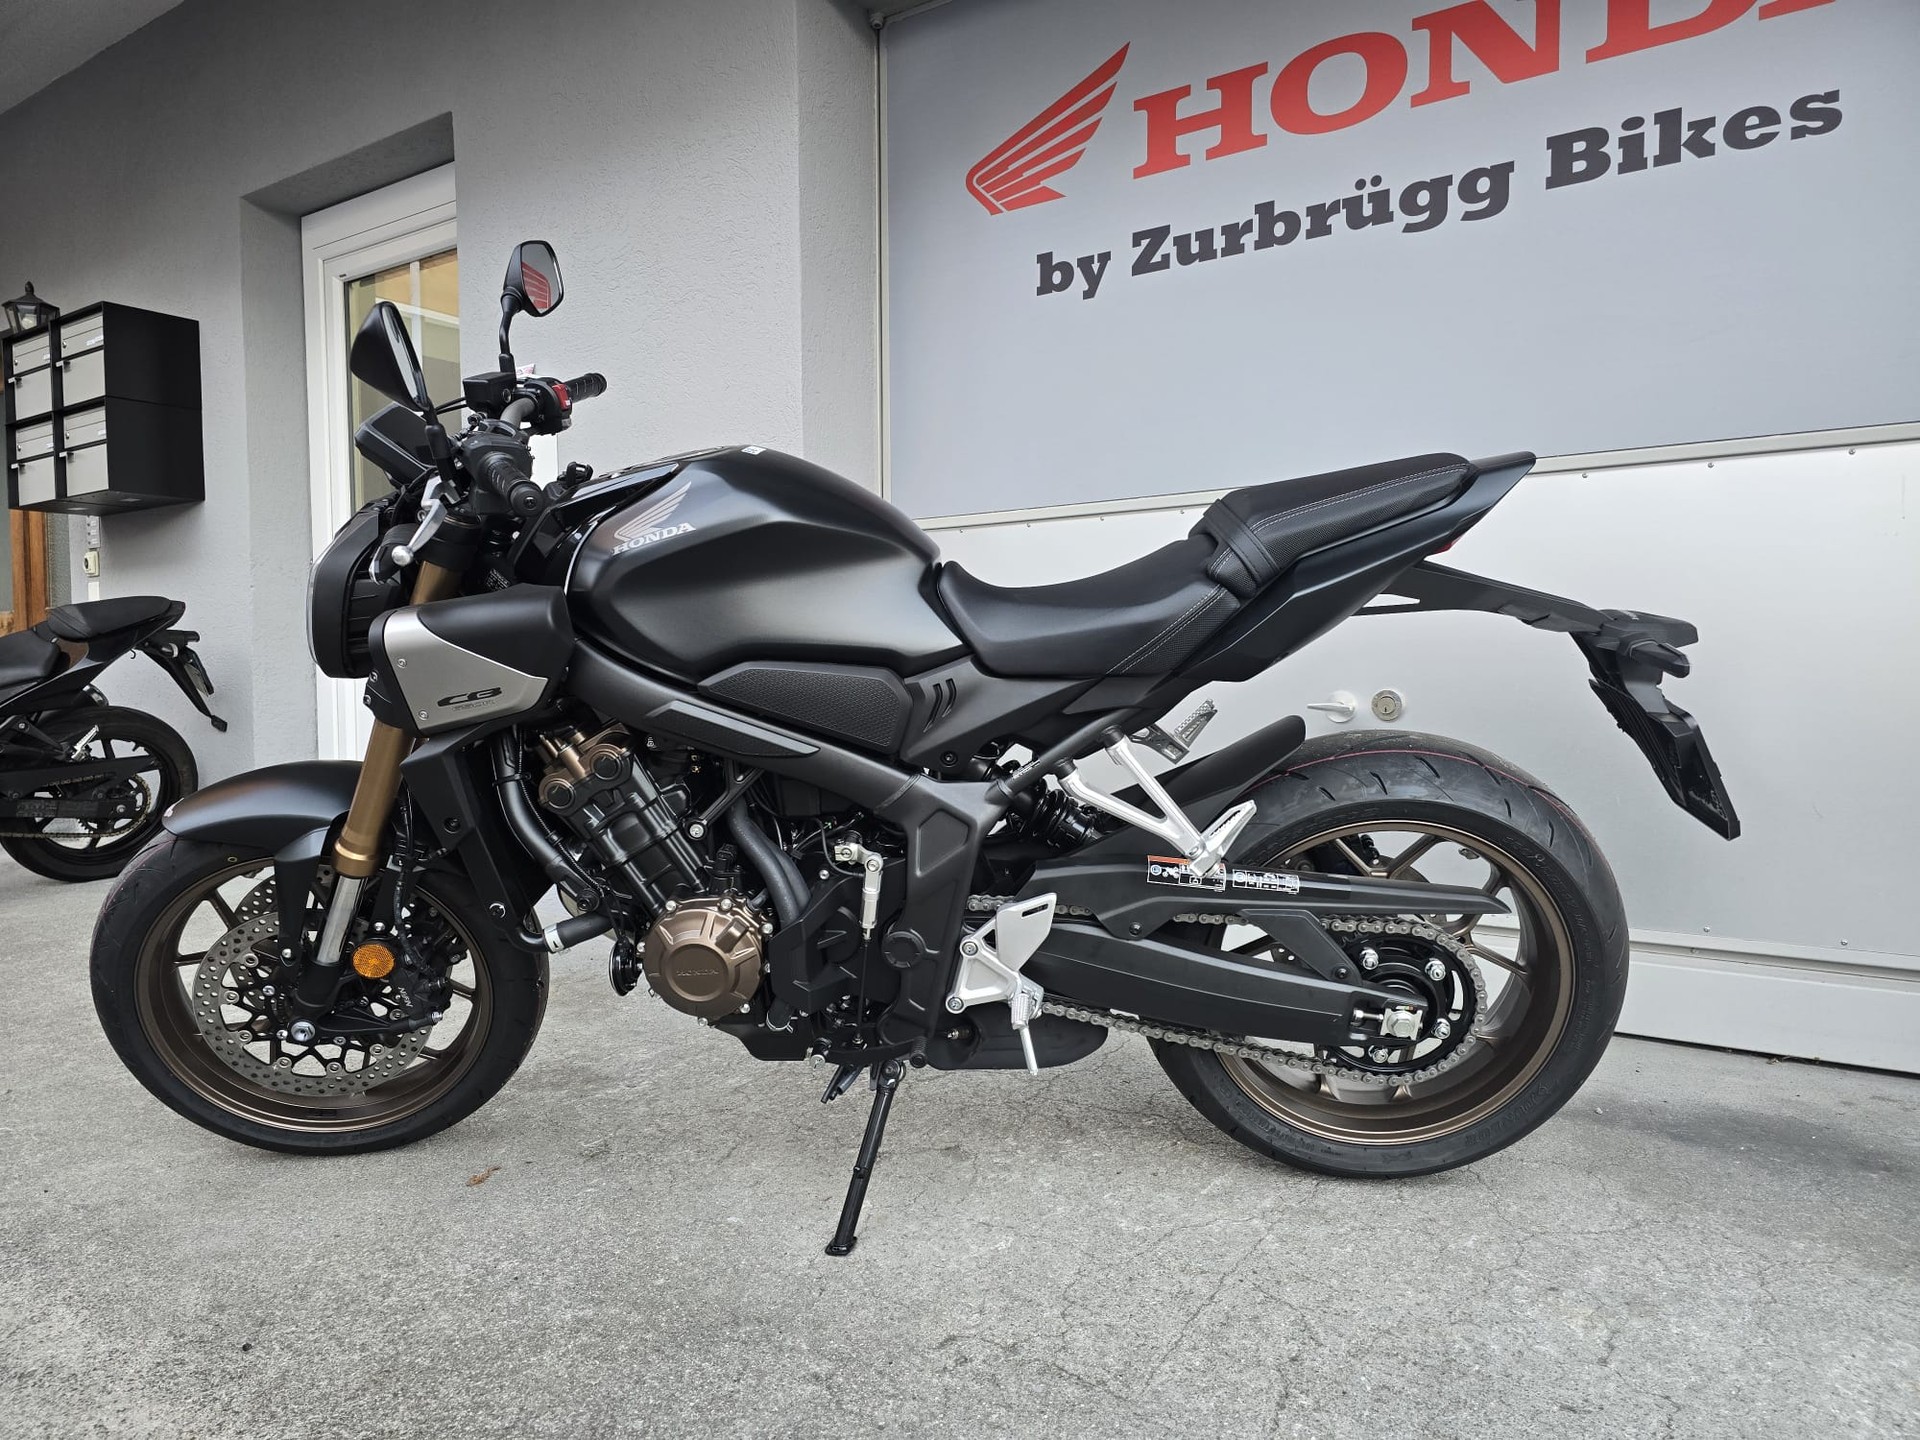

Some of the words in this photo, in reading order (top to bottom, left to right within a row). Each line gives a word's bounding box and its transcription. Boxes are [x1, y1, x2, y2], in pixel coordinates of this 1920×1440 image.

[1036, 250, 1112, 301] by
[1131, 160, 1515, 277] Zurbrügg
[1545, 89, 1843, 190] Bikes
[611, 522, 697, 556] HONDA
[437, 687, 502, 707] CB
